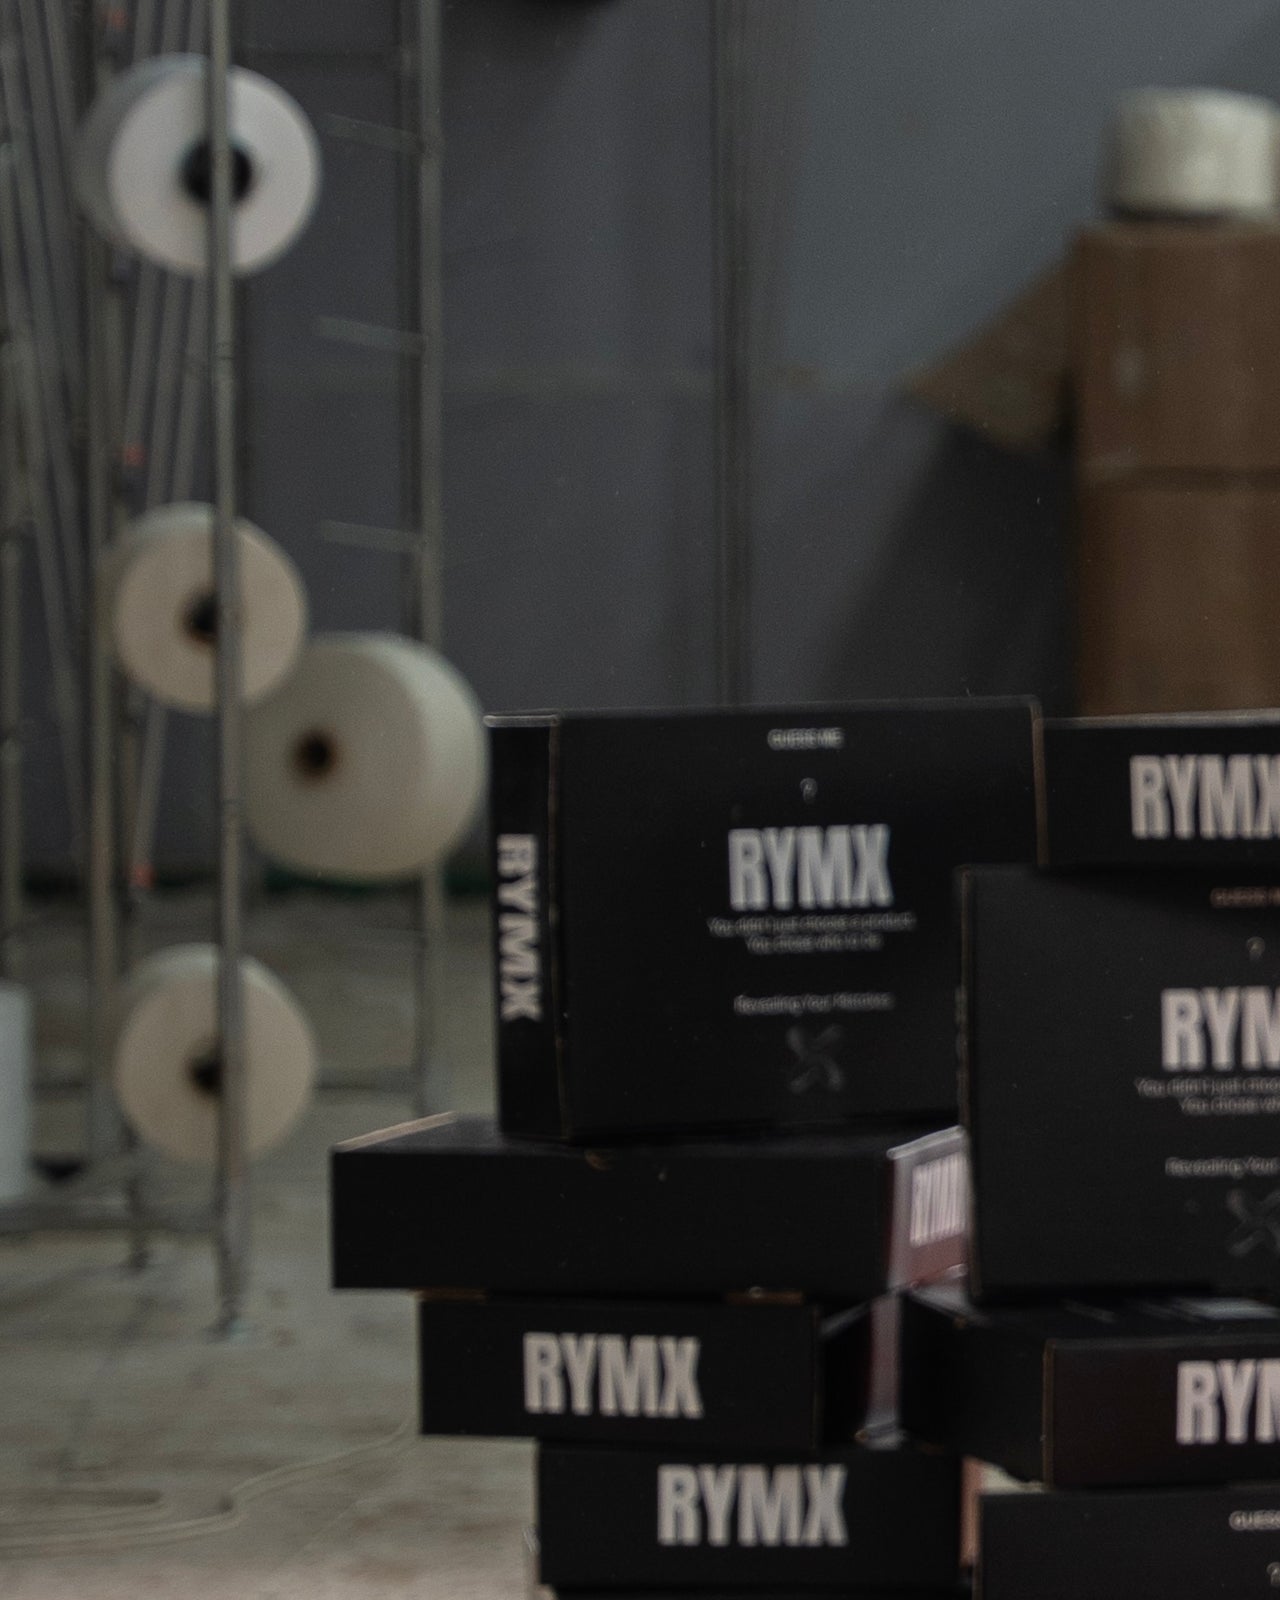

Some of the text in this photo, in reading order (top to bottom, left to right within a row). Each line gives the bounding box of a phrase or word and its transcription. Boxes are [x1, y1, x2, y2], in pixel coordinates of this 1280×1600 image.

[728, 824, 894, 912] RYMX
[497, 833, 542, 1022] RYMX
[524, 1333, 702, 1416] RYMX
[658, 1464, 847, 1546] RYMX
